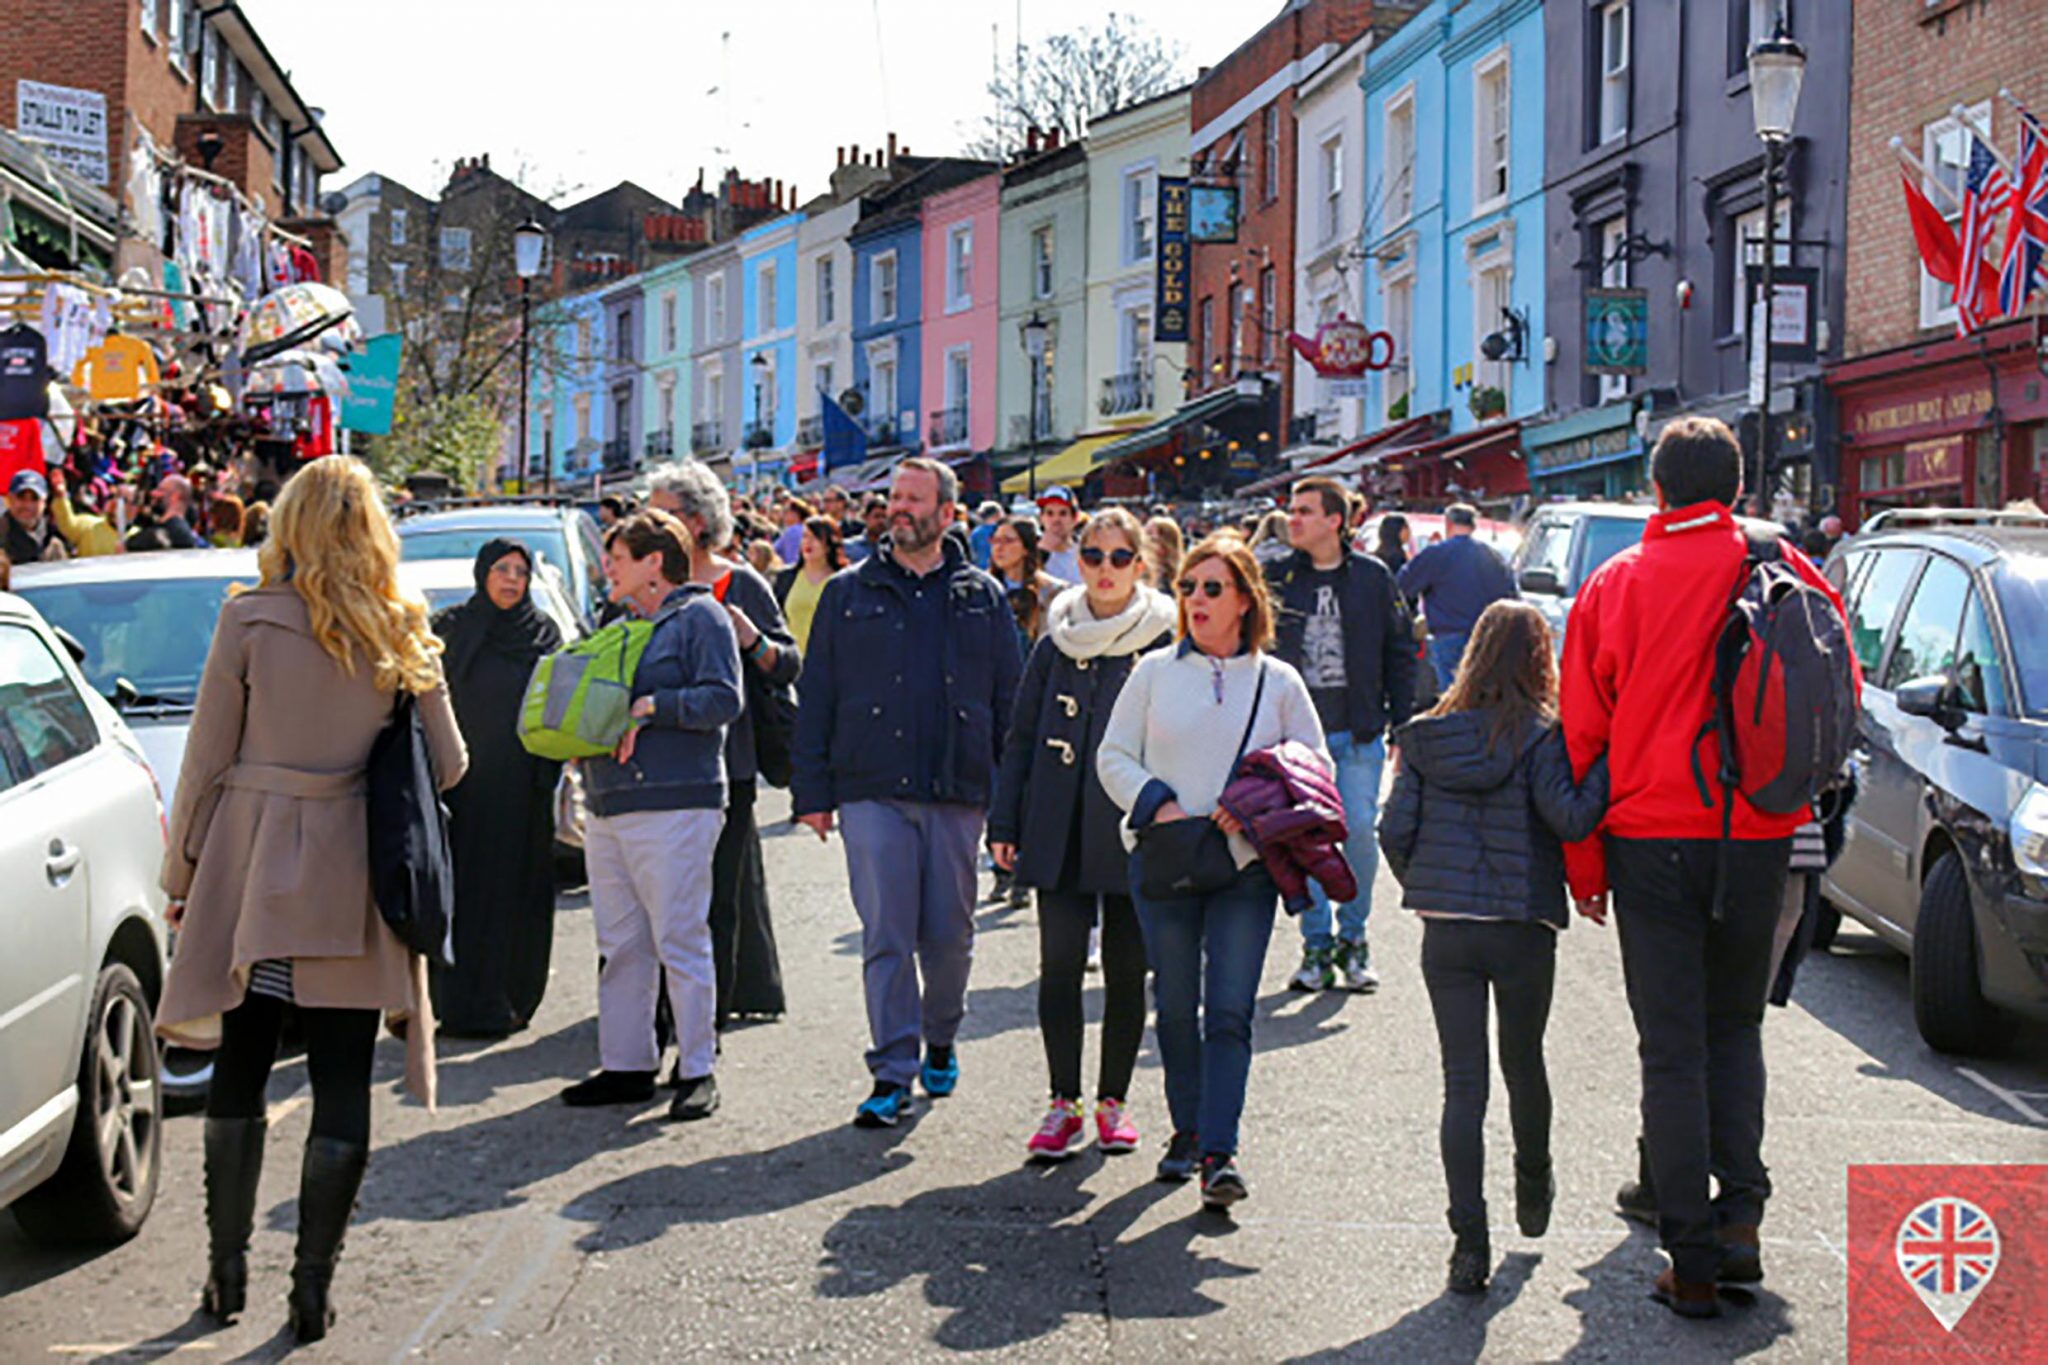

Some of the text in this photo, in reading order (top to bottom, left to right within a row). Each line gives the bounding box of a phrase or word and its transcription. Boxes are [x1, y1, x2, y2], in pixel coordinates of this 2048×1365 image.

[22, 100, 101, 135] STALLS TO LET
[1163, 185, 1186, 232] THE
[1163, 241, 1184, 305] GOLD
